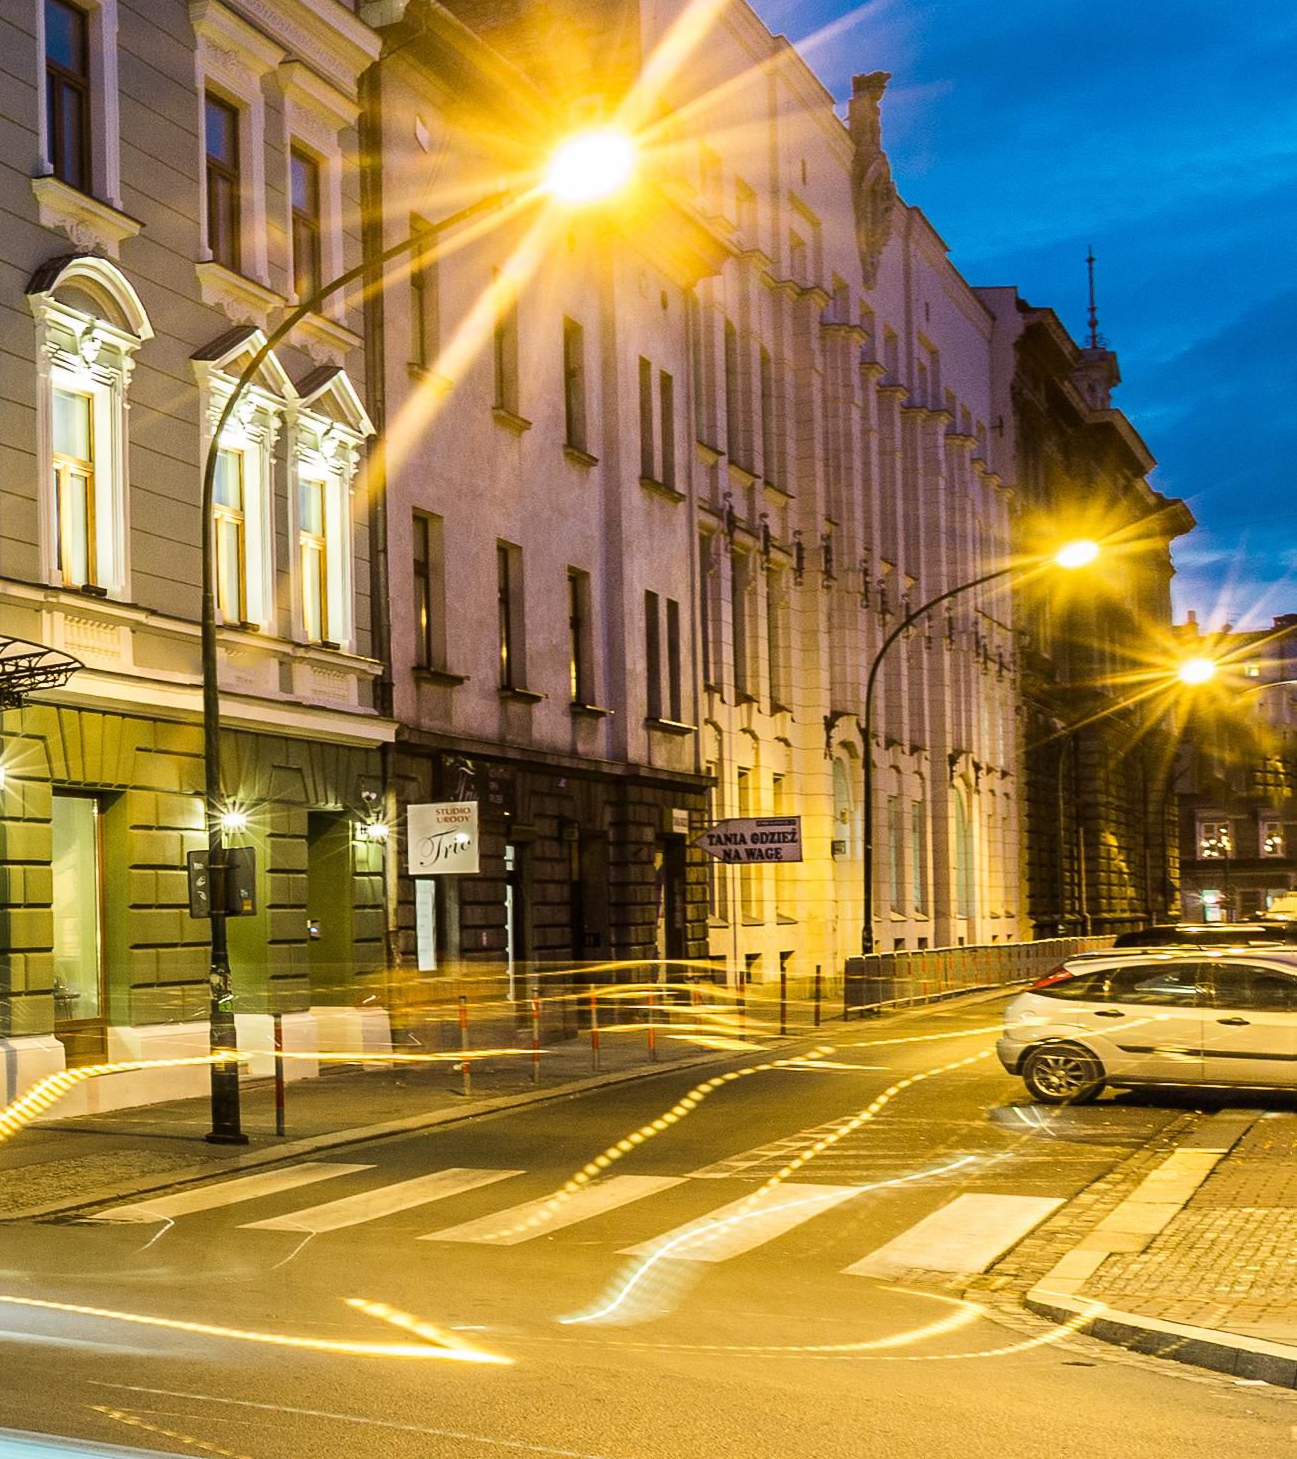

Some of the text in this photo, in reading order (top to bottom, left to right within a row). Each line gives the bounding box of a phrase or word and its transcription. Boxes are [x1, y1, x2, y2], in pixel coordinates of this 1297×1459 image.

[435, 807, 471, 816] STUDIO
[707, 832, 747, 846] TANIA
[722, 848, 742, 861] NA
